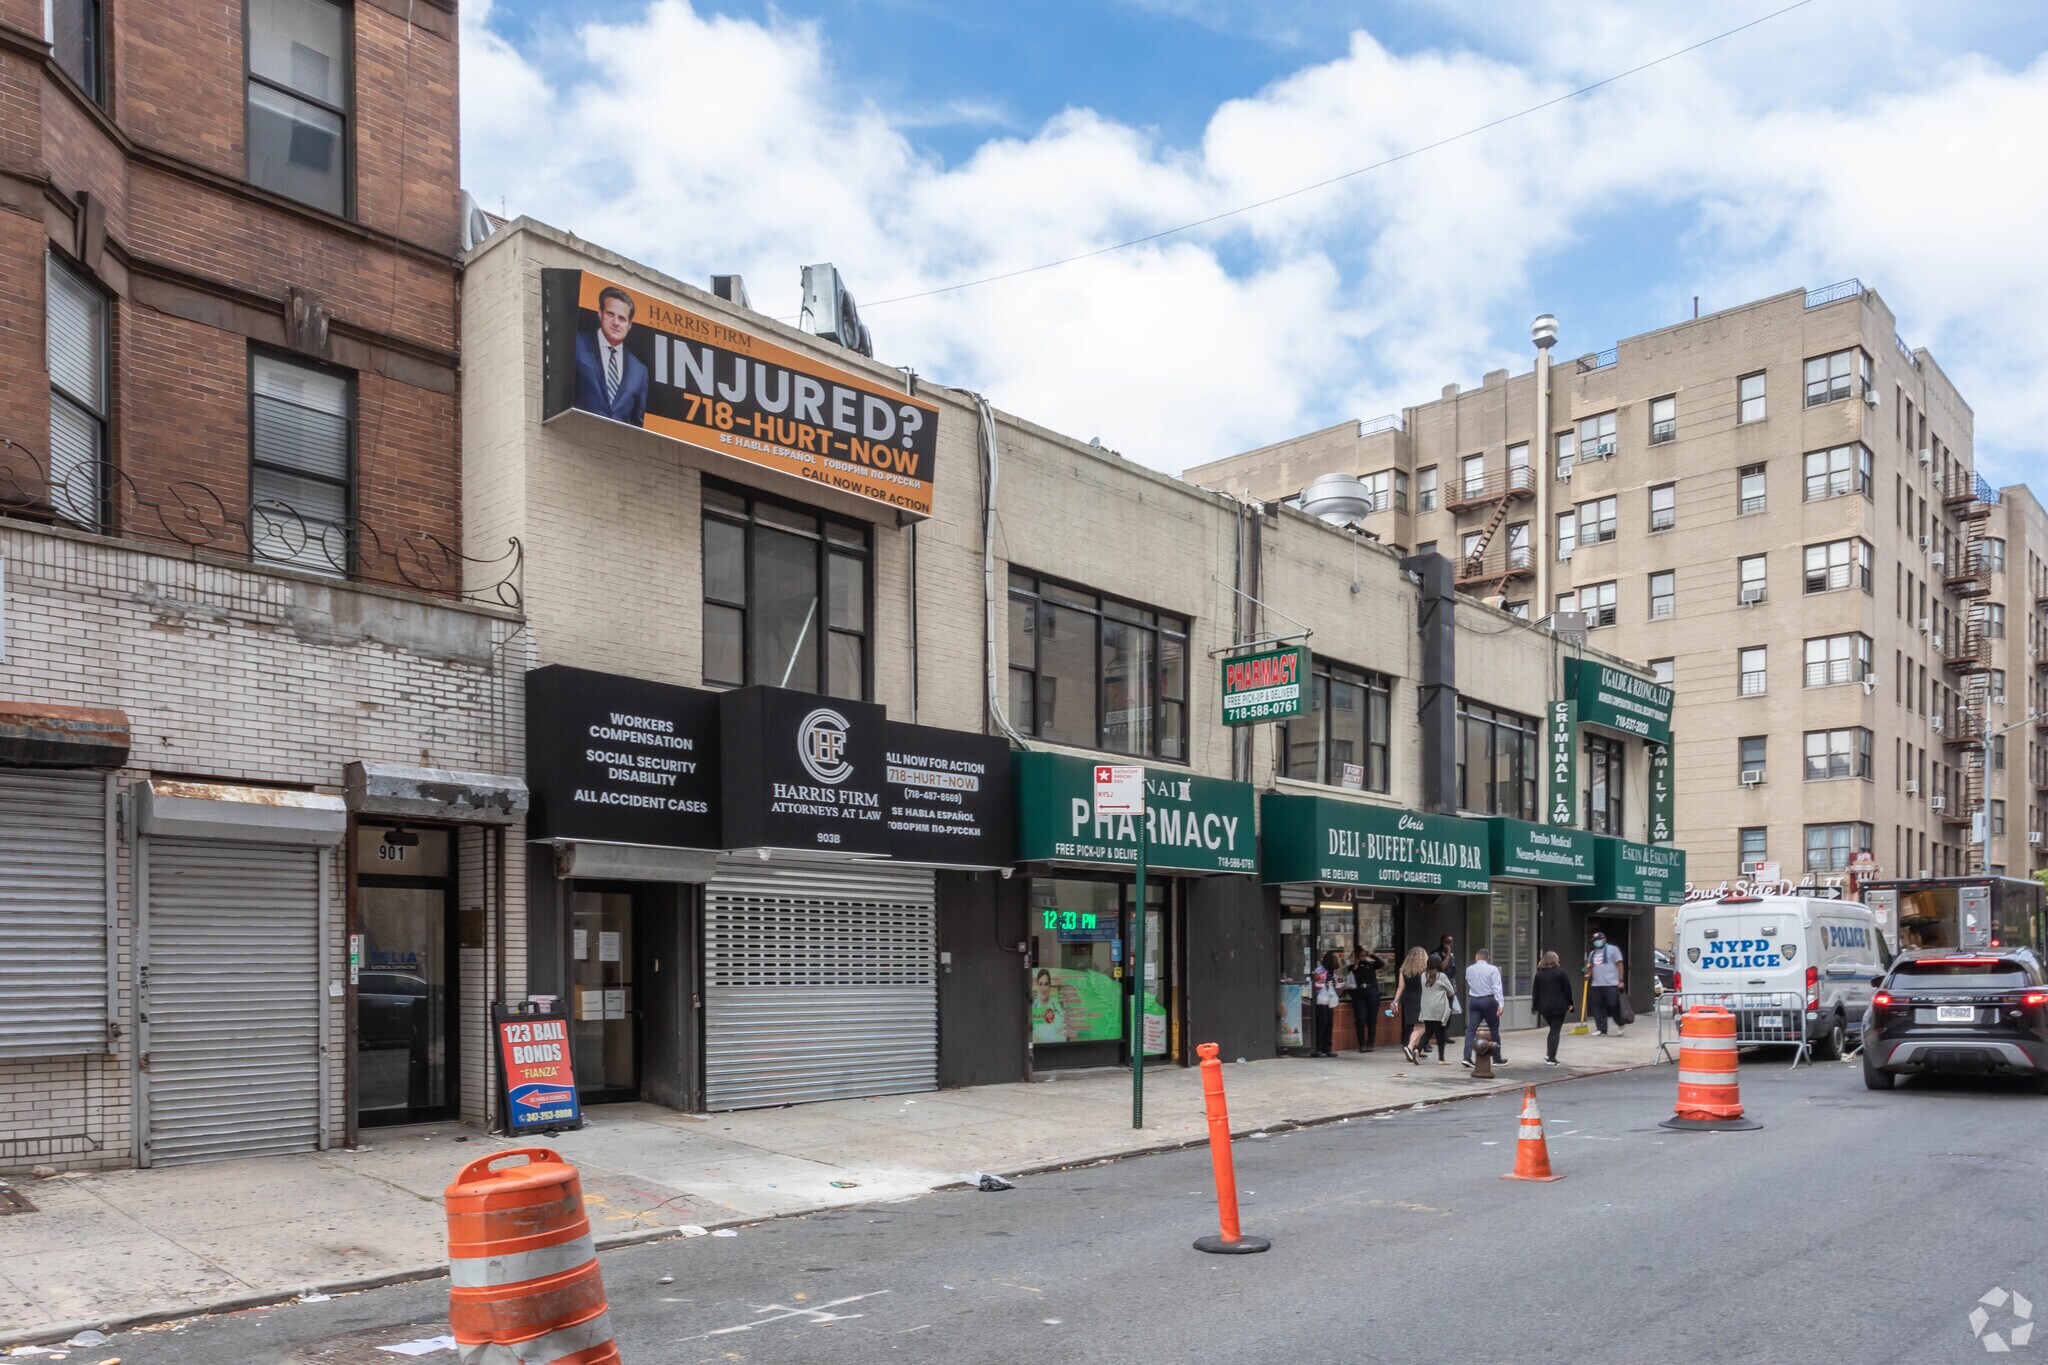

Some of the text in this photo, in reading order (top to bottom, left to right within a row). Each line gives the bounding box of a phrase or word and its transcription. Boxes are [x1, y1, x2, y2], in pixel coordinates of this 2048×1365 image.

[649, 305, 751, 348] HARRIS FIRM
[655, 334, 924, 449] INJURED?
[683, 393, 920, 476] 718-HURT-NOW
[719, 433, 816, 464] SE HABLA ESPAÑOL
[823, 458, 921, 489] ГОВОРИМ ПО-РУССКИ
[802, 467, 930, 514] CALL NOW FOR ACTION
[1226, 652, 1298, 693] PHARMACY
[1227, 696, 1241, 706] FREE
[1271, 686, 1297, 699] DELIVERY
[1627, 677, 1633, 694] &
[1658, 688, 1671, 707] LLP
[1228, 700, 1297, 720] 718-588-0761
[610, 712, 674, 733] WORKERS
[589, 725, 693, 750] COMPENSATION
[586, 749, 697, 774] SOCIAL SECURITY
[903, 754, 928, 767] NOW
[929, 758, 948, 770] FOR
[949, 761, 985, 774] ACTION
[1553, 702, 1570, 823] CRIMINAL LAW
[608, 768, 677, 786] DISABILITY
[889, 769, 976, 789] 718-HURT-NOW
[574, 789, 708, 813] ALL ACCIDENT CASES
[773, 783, 880, 807] HARRIS FIRM
[1653, 745, 1669, 840] AMILY LAW
[771, 802, 882, 821] ATTORNEYS AT LAW
[892, 807, 975, 822] SE HABLA ESPAÑOL
[931, 825, 981, 836] ПО-РУССКИ
[1072, 798, 1238, 850] PHARMACY
[1398, 814, 1425, 831] Chris
[817, 833, 841, 843] 903B
[1328, 828, 1482, 869] DELI BUFFET SALAD BAR
[380, 845, 404, 861] 901
[1056, 843, 1075, 855] FREE
[1077, 845, 1105, 857] PICK-UP
[1107, 847, 1112, 858] &
[1643, 847, 1649, 863] &
[1321, 868, 1359, 881] WE DELIVER
[1635, 865, 1669, 878] LAW OFFICES
[1685, 880, 1730, 900] Court
[1732, 880, 1776, 898] Side
[1780, 876, 1814, 897] Dli
[1043, 910, 1096, 930] 12:33 PM
[1710, 939, 1770, 953] NYPD
[1830, 925, 1865, 949] POLICE
[1702, 954, 1780, 969] POLICE
[504, 1022, 564, 1043] 123 BAIL
[512, 1043, 562, 1064] BONDS
